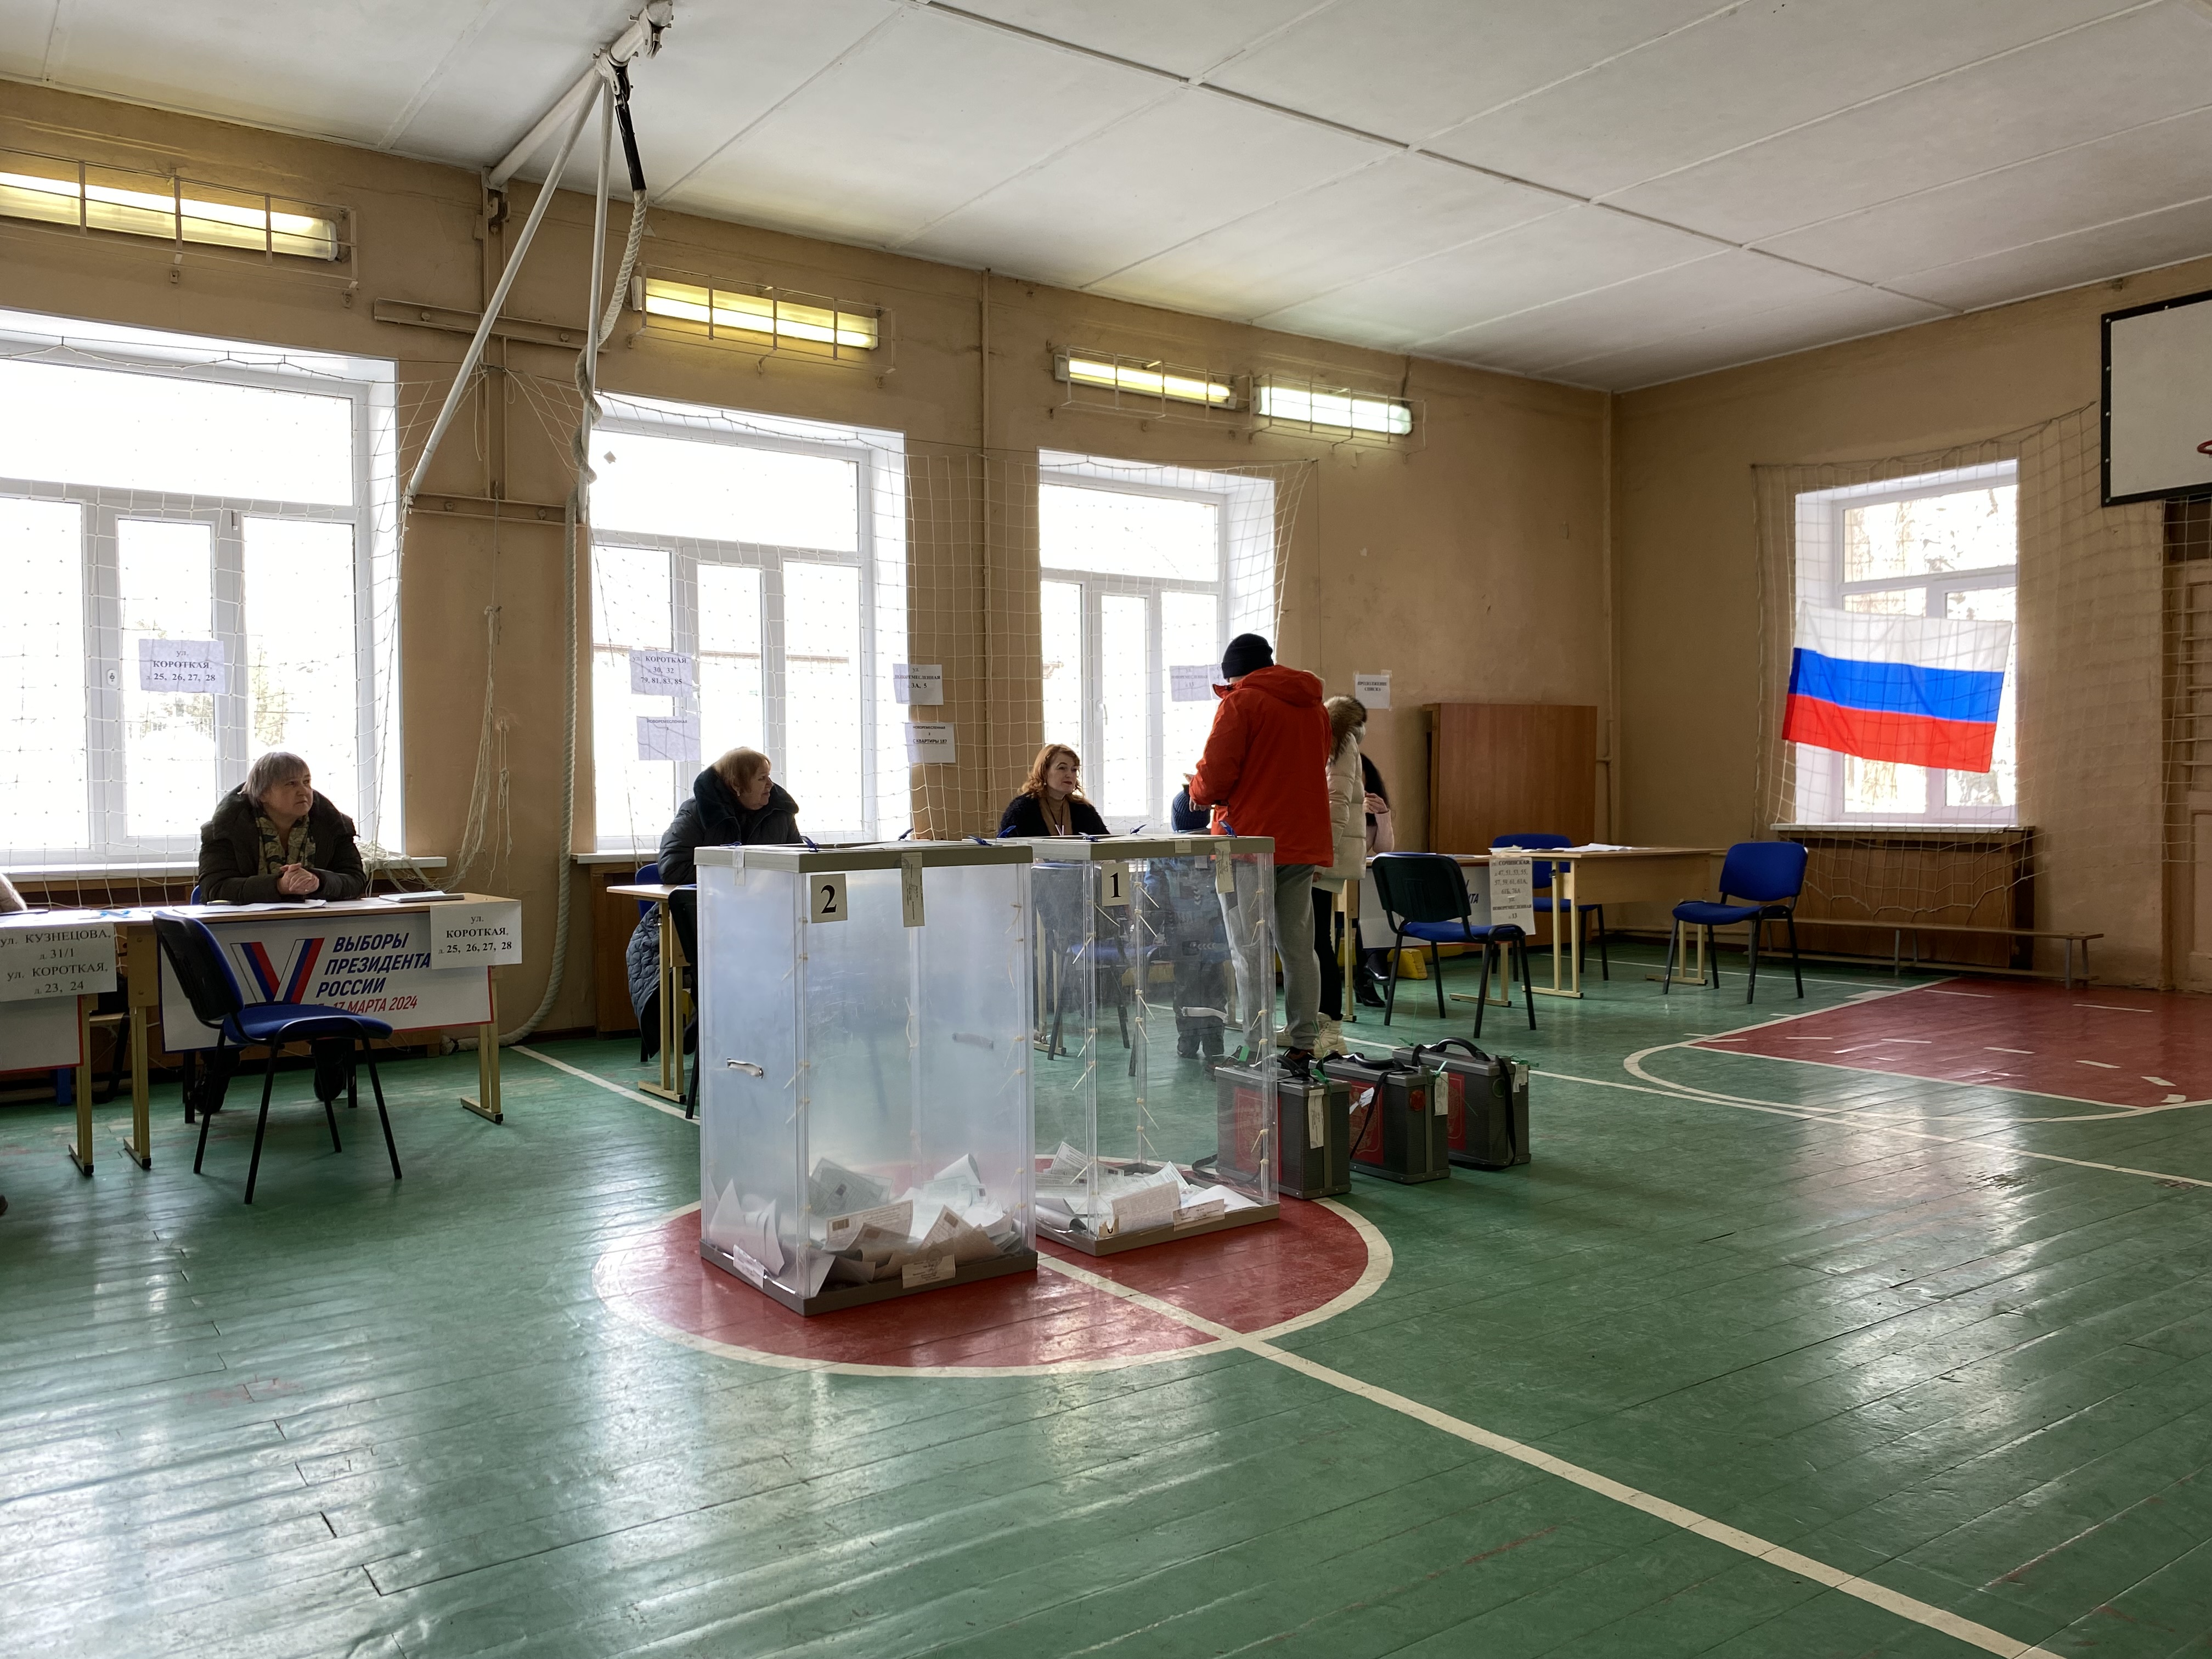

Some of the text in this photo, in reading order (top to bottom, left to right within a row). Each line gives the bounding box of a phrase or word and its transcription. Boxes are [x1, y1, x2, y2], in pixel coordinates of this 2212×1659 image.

[154, 673, 167, 681] 25,
[172, 673, 185, 681] 26,
[188, 674, 201, 682] 27,
[1110, 872, 1121, 898] 1
[820, 884, 837, 913] 2
[1, 929, 111, 947] ул. КУЗНЕЦОВА,
[332, 933, 409, 952] ВЫБОРЫ
[50, 948, 74, 959] 31/1
[447, 945, 461, 954] 25,
[466, 944, 479, 952] 26,
[483, 943, 496, 952] 27,
[501, 941, 512, 950] 28
[7, 962, 108, 981] ул. КОРОТКАЯ,
[324, 952, 431, 975] ПРЕЗИДЕНТА
[45, 983, 63, 994] 23,
[70, 981, 84, 991] 24
[315, 977, 386, 998] РОССИИ
[347, 998, 387, 1013] МАРТА
[388, 995, 418, 1011] 2024
